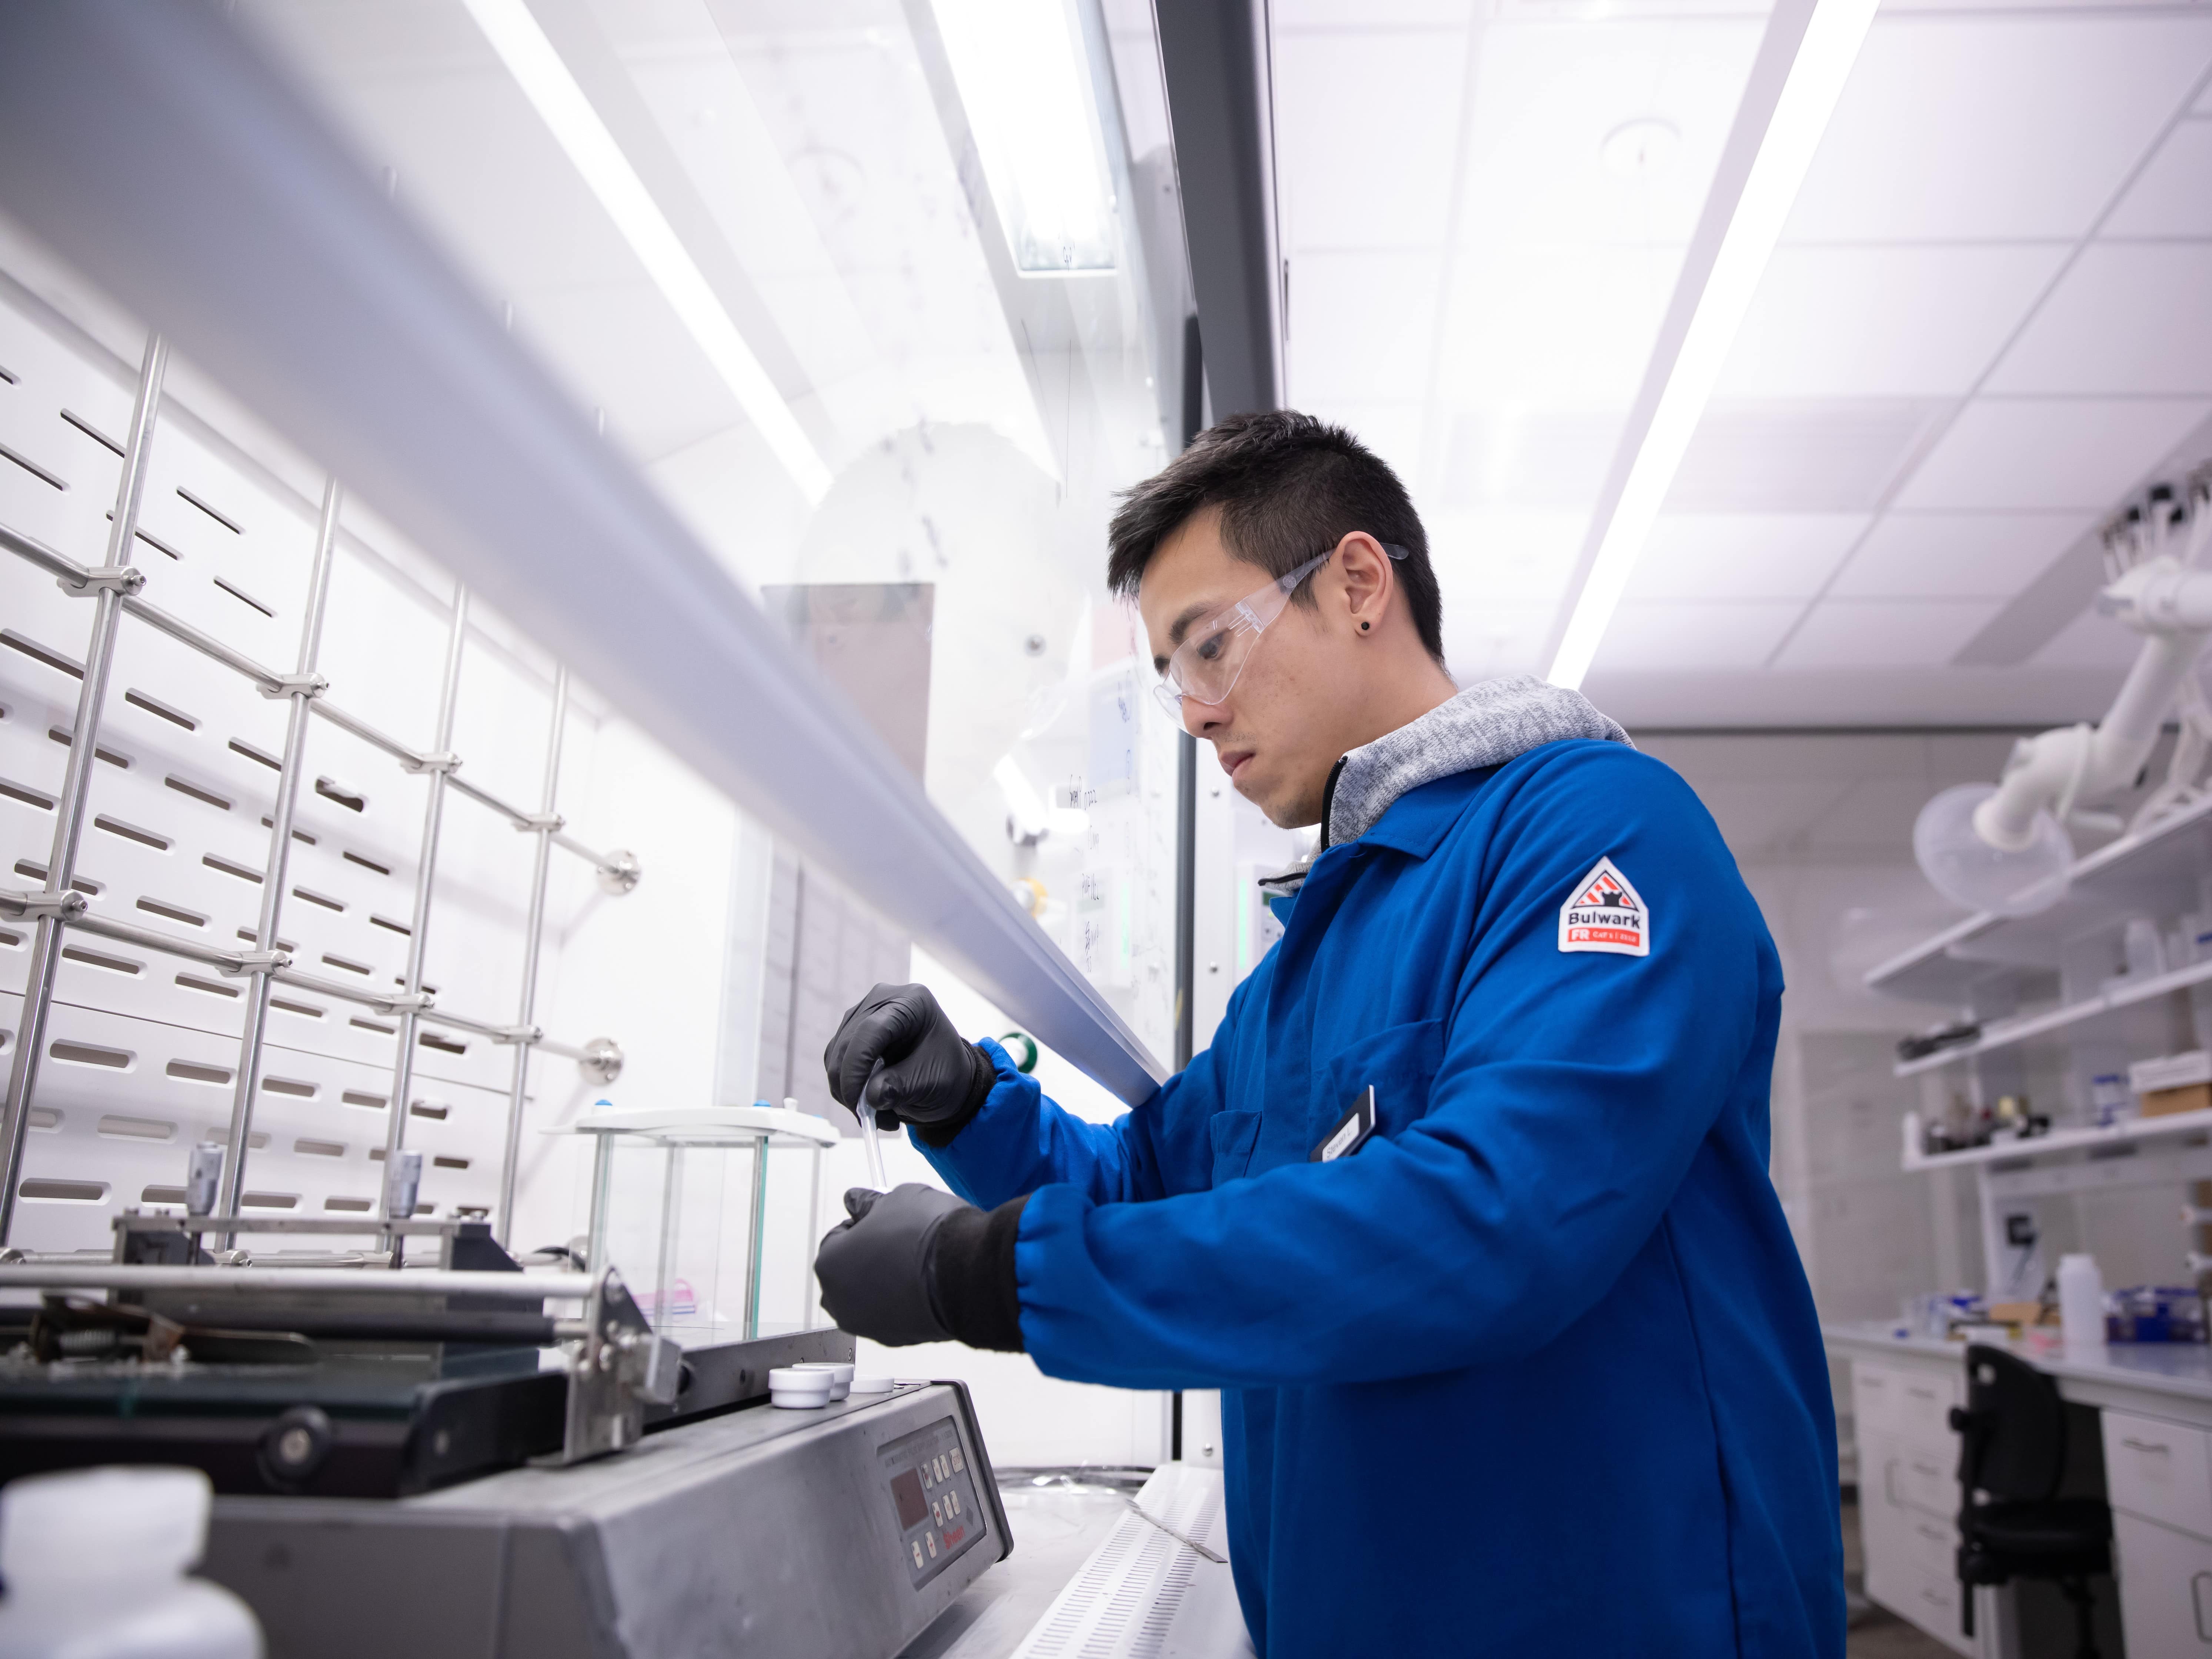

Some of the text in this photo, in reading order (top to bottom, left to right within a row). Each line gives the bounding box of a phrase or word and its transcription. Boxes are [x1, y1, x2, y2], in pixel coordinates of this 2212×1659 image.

[1569, 911, 1640, 929] Bulwark
[1571, 929, 1590, 940] FR
[1327, 1134, 1345, 1159] Steven
